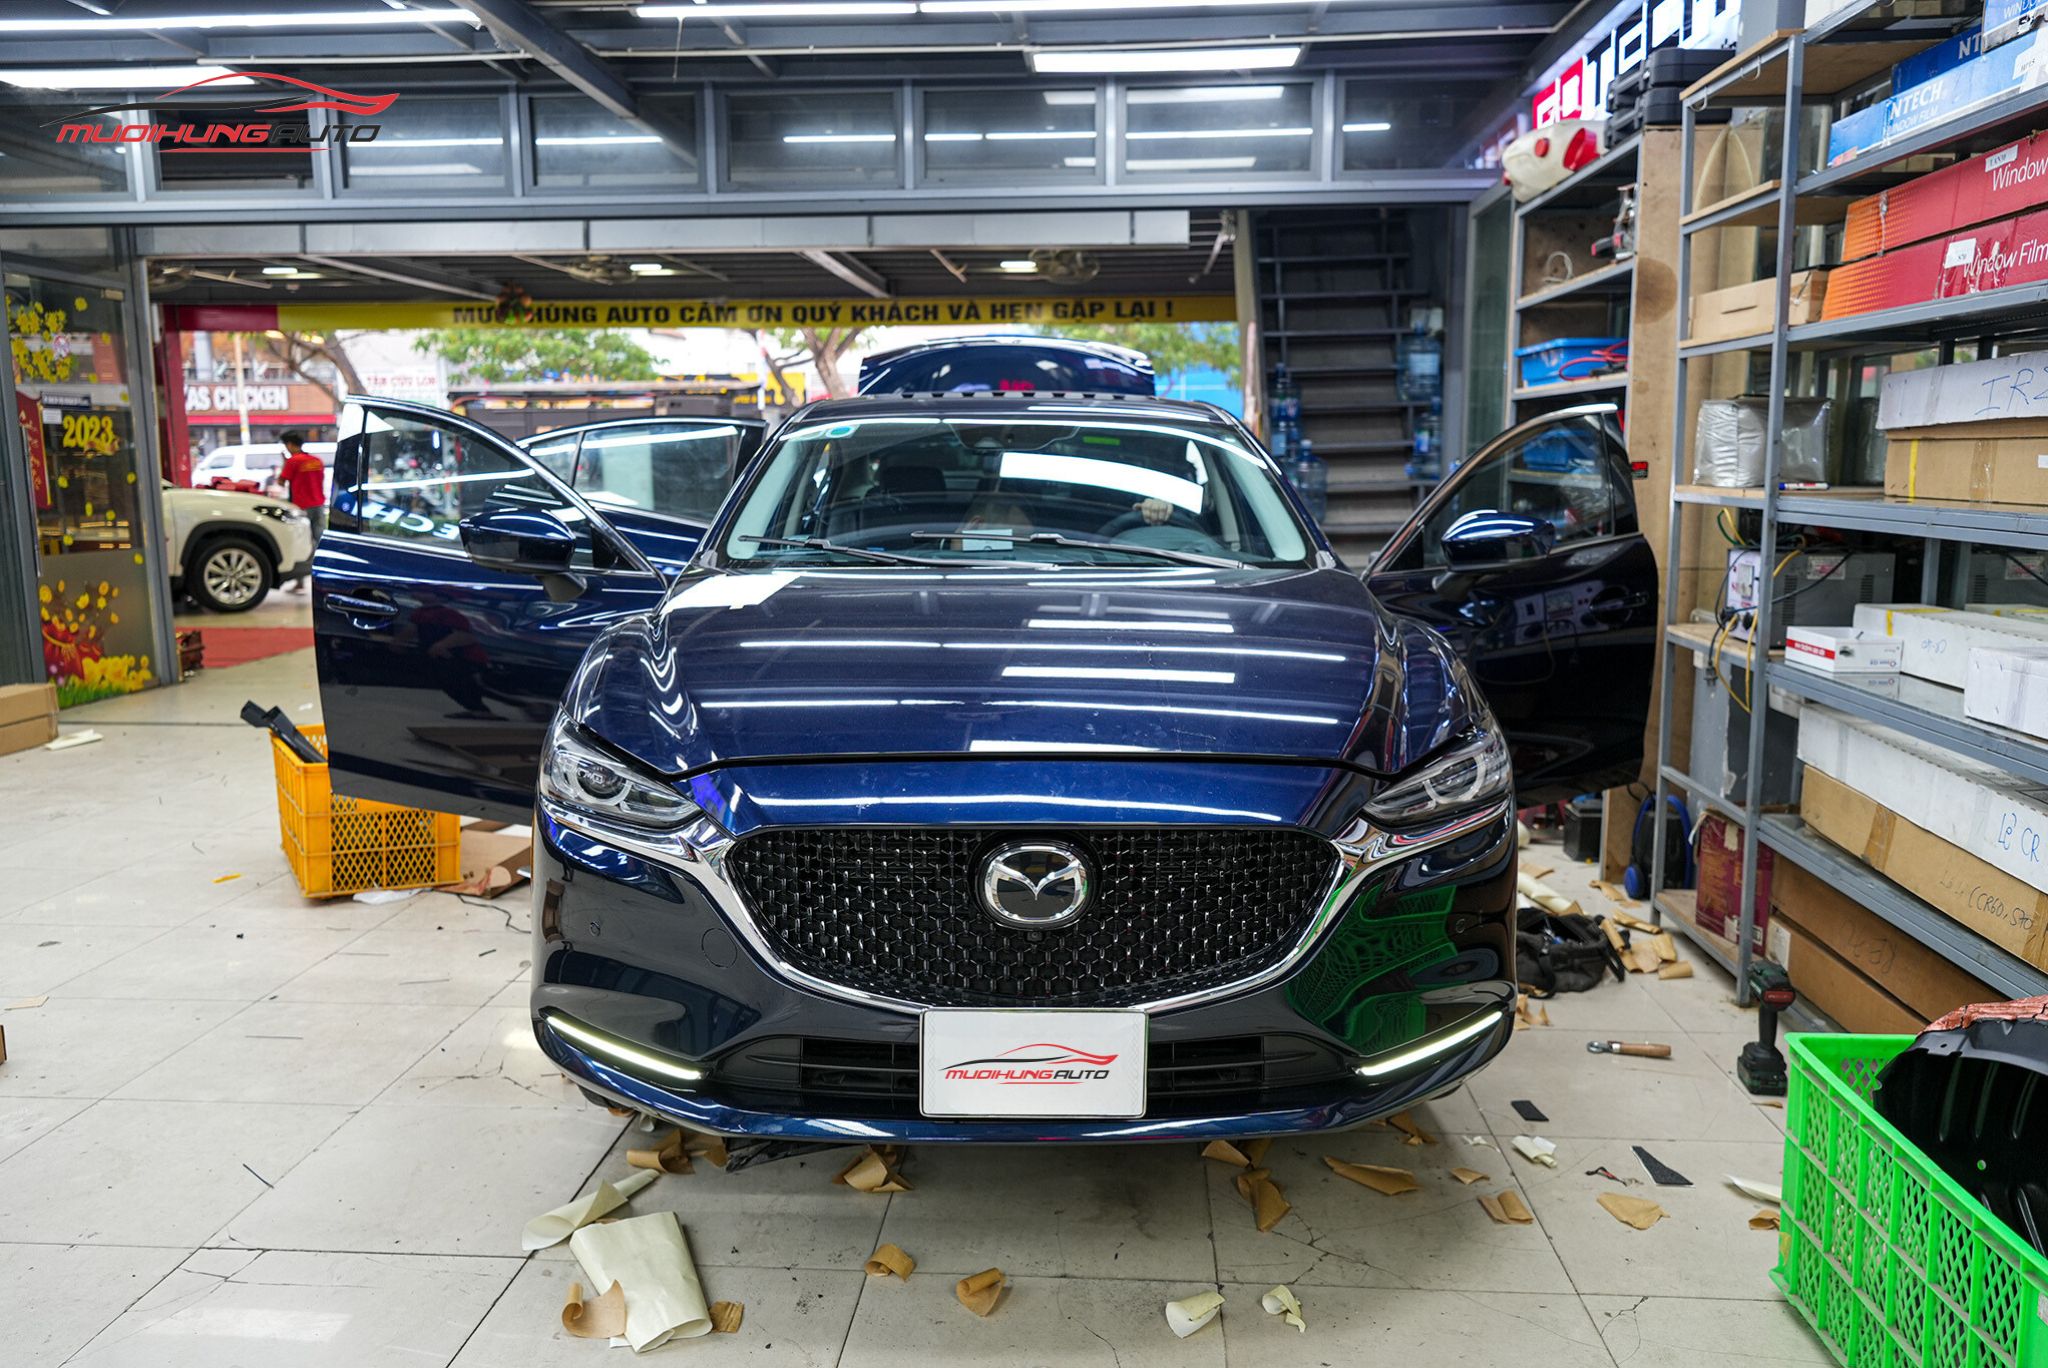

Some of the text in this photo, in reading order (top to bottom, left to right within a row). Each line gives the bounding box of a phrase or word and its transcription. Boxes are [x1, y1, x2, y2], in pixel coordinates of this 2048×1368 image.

[1992, 156, 2048, 192] Window
[1963, 245, 2018, 278] Window
[453, 304, 526, 324] MƯ
[606, 305, 670, 323] AUTO
[748, 304, 782, 323] ƠN
[792, 301, 842, 324] QUÝ
[851, 300, 941, 322] KHÁCH
[948, 300, 981, 321] VÀ
[1115, 302, 1157, 322] LẠI
[184, 386, 289, 411] AS CHCKEN
[62, 414, 116, 450] 2023
